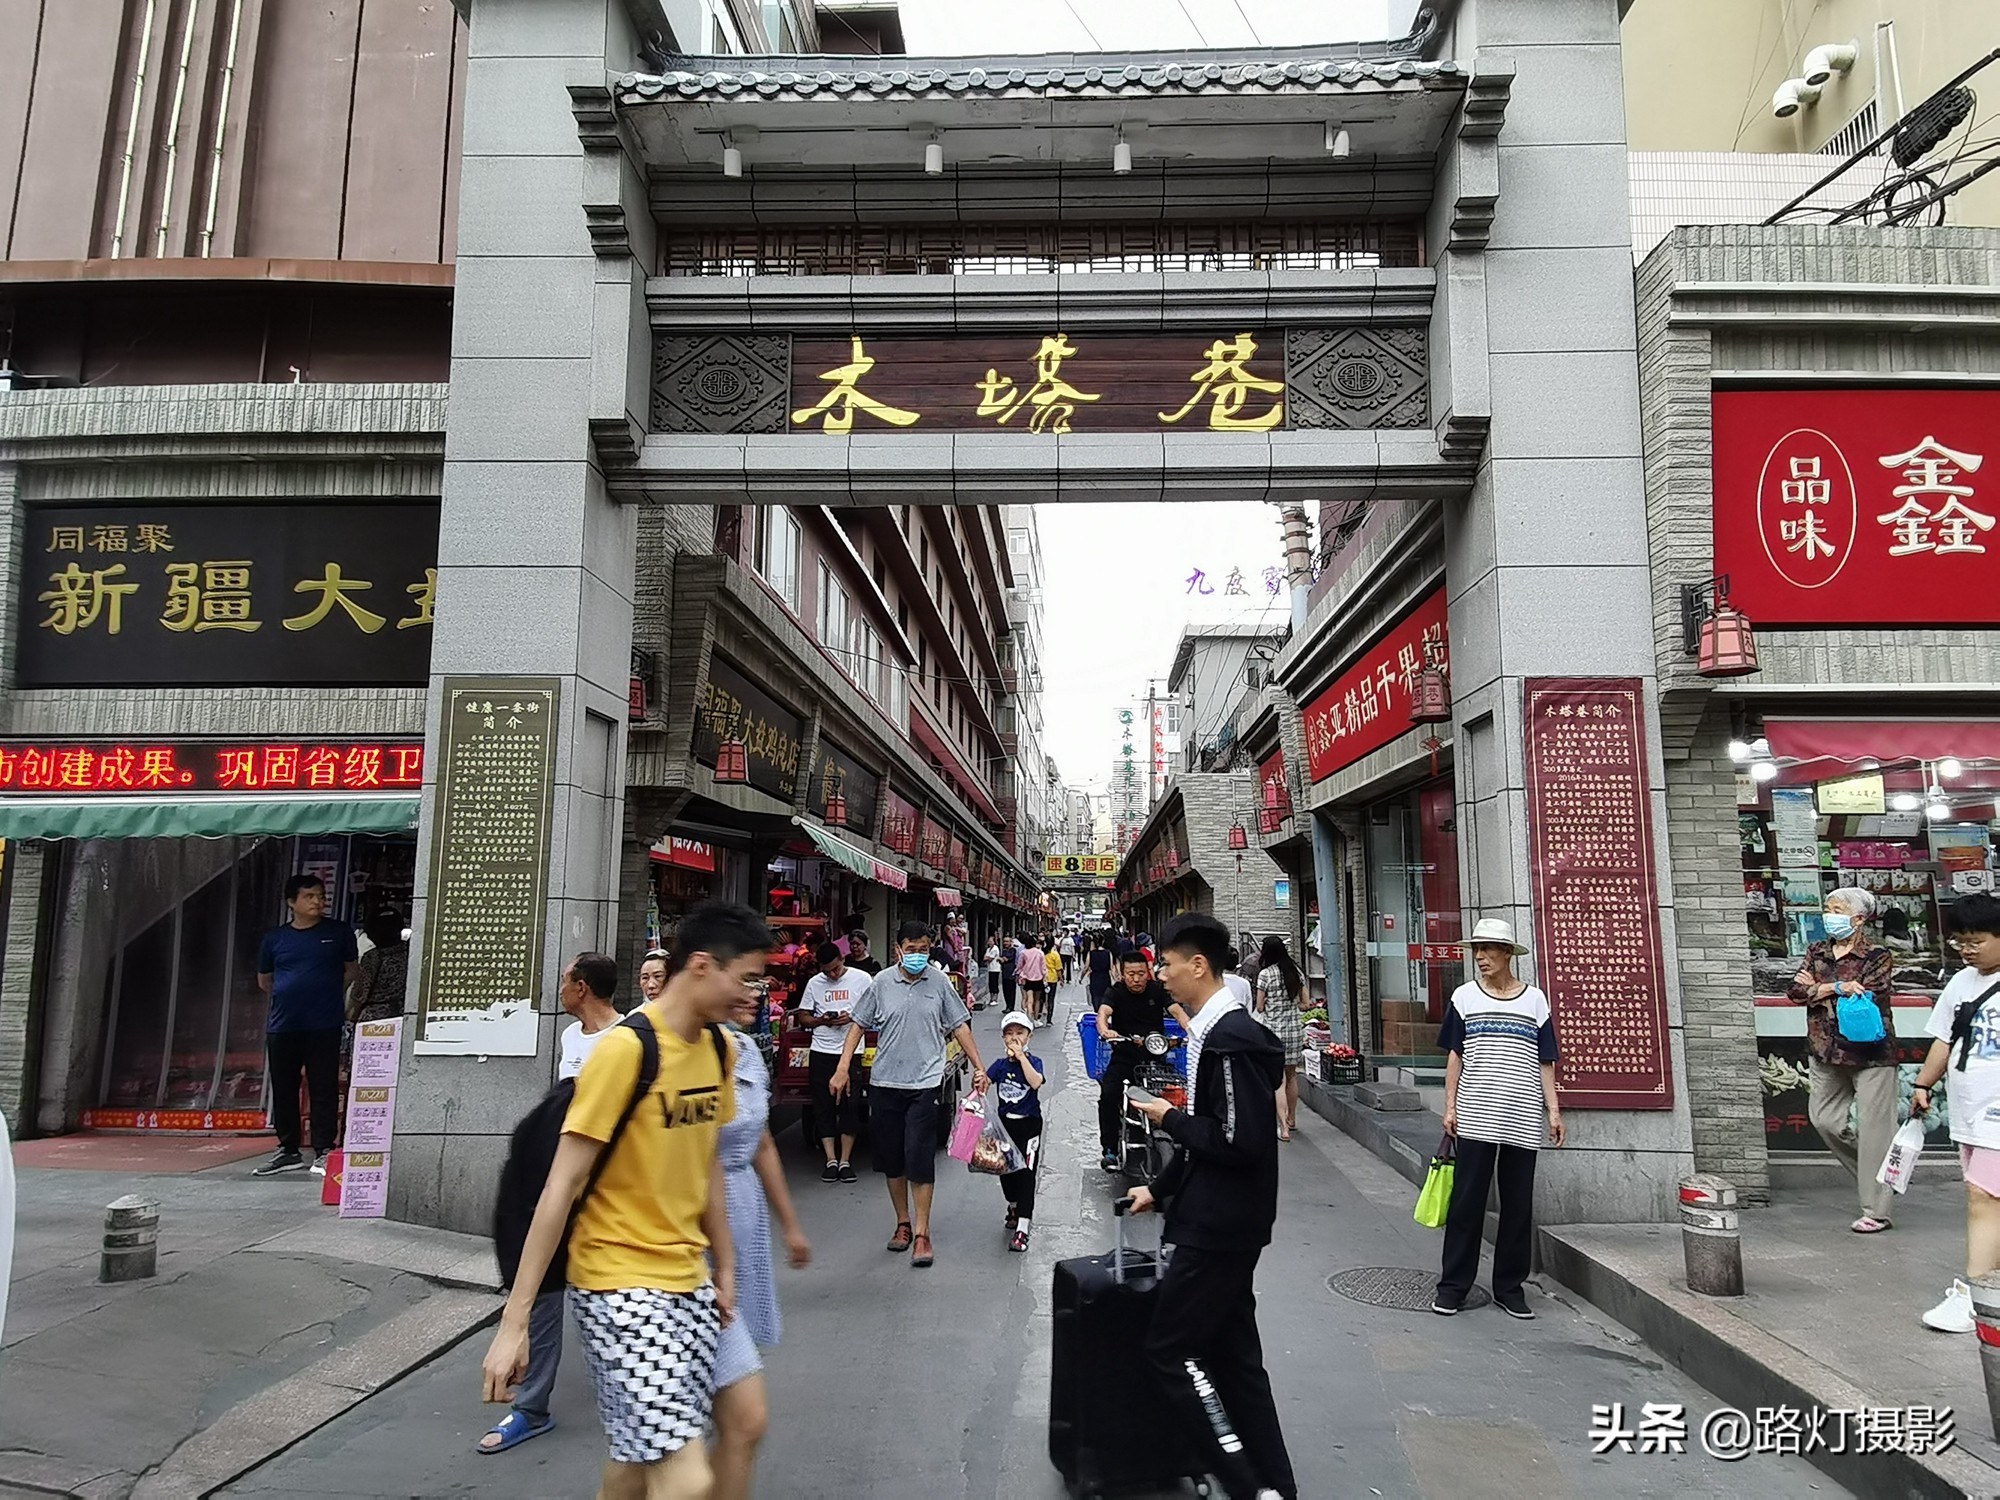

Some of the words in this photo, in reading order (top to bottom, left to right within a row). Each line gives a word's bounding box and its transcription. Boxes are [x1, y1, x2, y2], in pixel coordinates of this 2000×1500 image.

[791, 332, 1286, 435] 木塔巷
[1876, 435, 1997, 557] 鑫
[1779, 455, 1836, 561] 品味
[45, 523, 175, 555] 同福聚
[465, 701, 540, 715] 健康一条街
[1544, 703, 1622, 718] 木塔巷简介
[483, 715, 523, 730] 简介
[1047, 857, 1115, 872] 速8酒店
